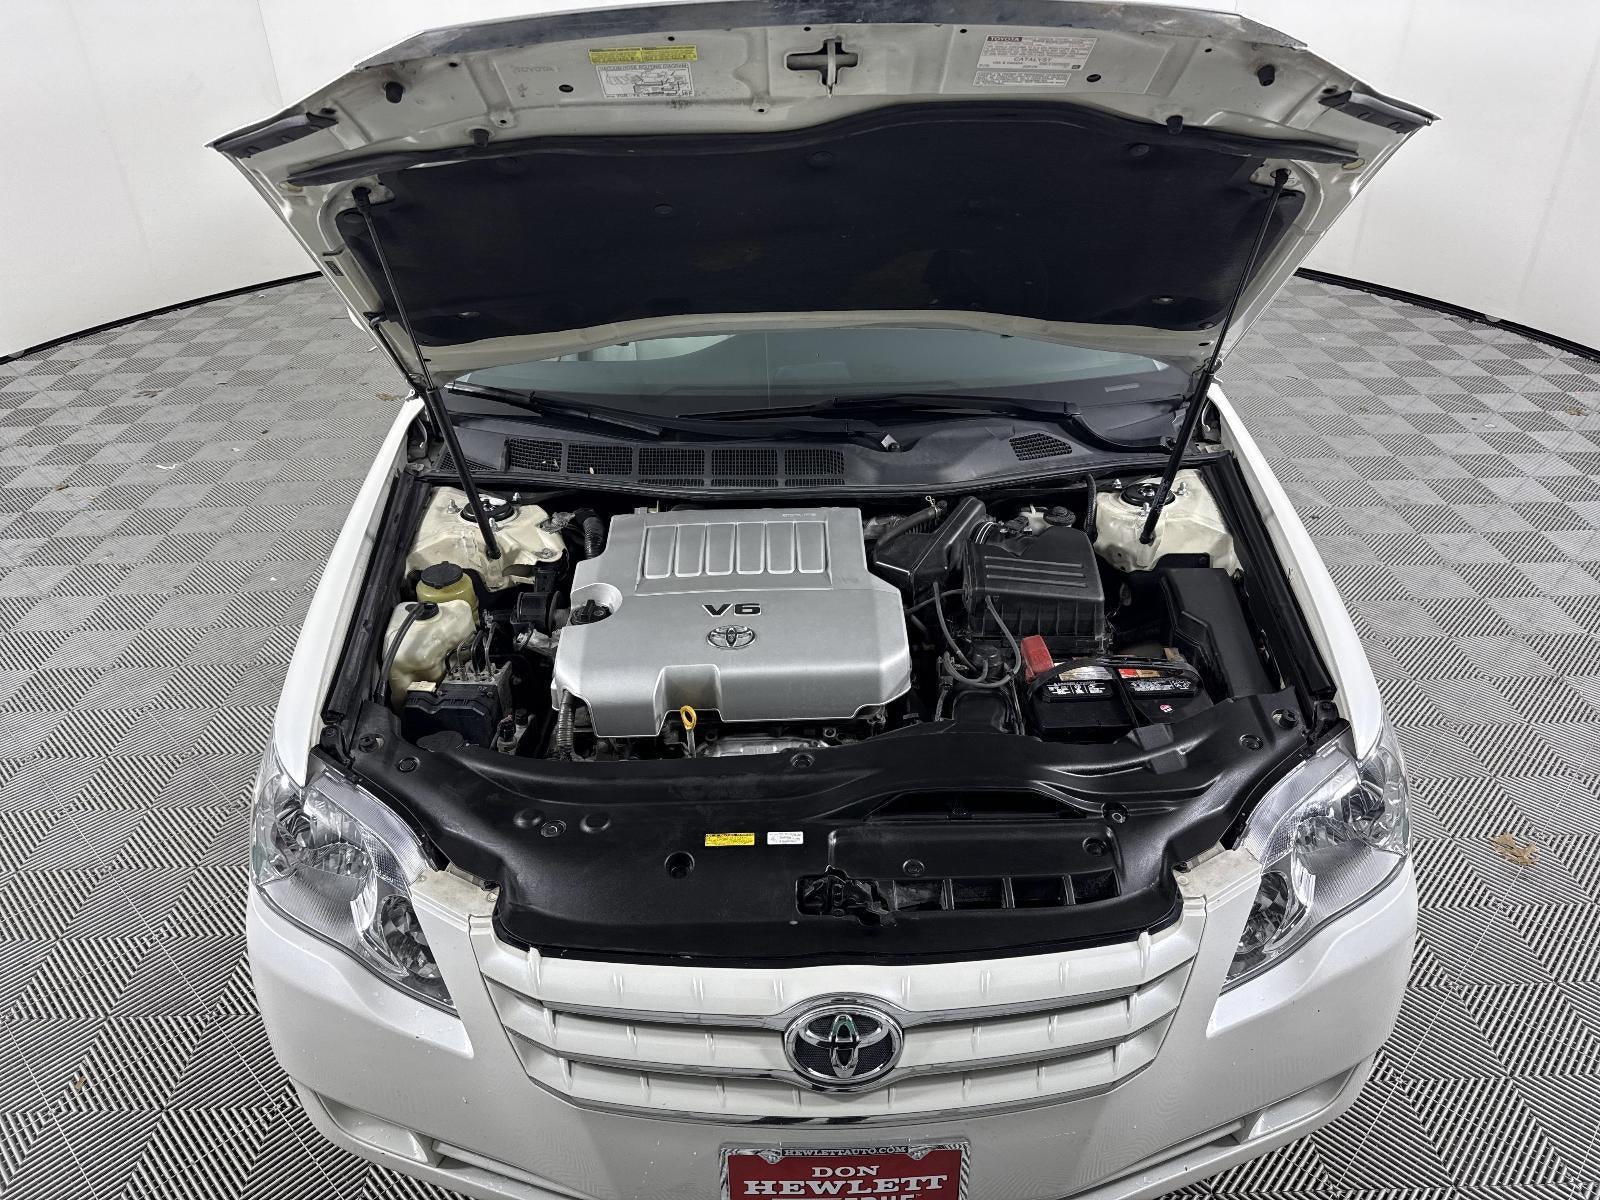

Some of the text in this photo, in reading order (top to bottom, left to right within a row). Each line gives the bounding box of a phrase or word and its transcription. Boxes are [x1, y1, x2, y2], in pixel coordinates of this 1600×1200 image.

[702, 603, 761, 617] V6
[784, 1146, 907, 1156] HEWLETTAUTO.COM
[812, 1165, 880, 1177] DON
[743, 1175, 948, 1195] HEWLETT
